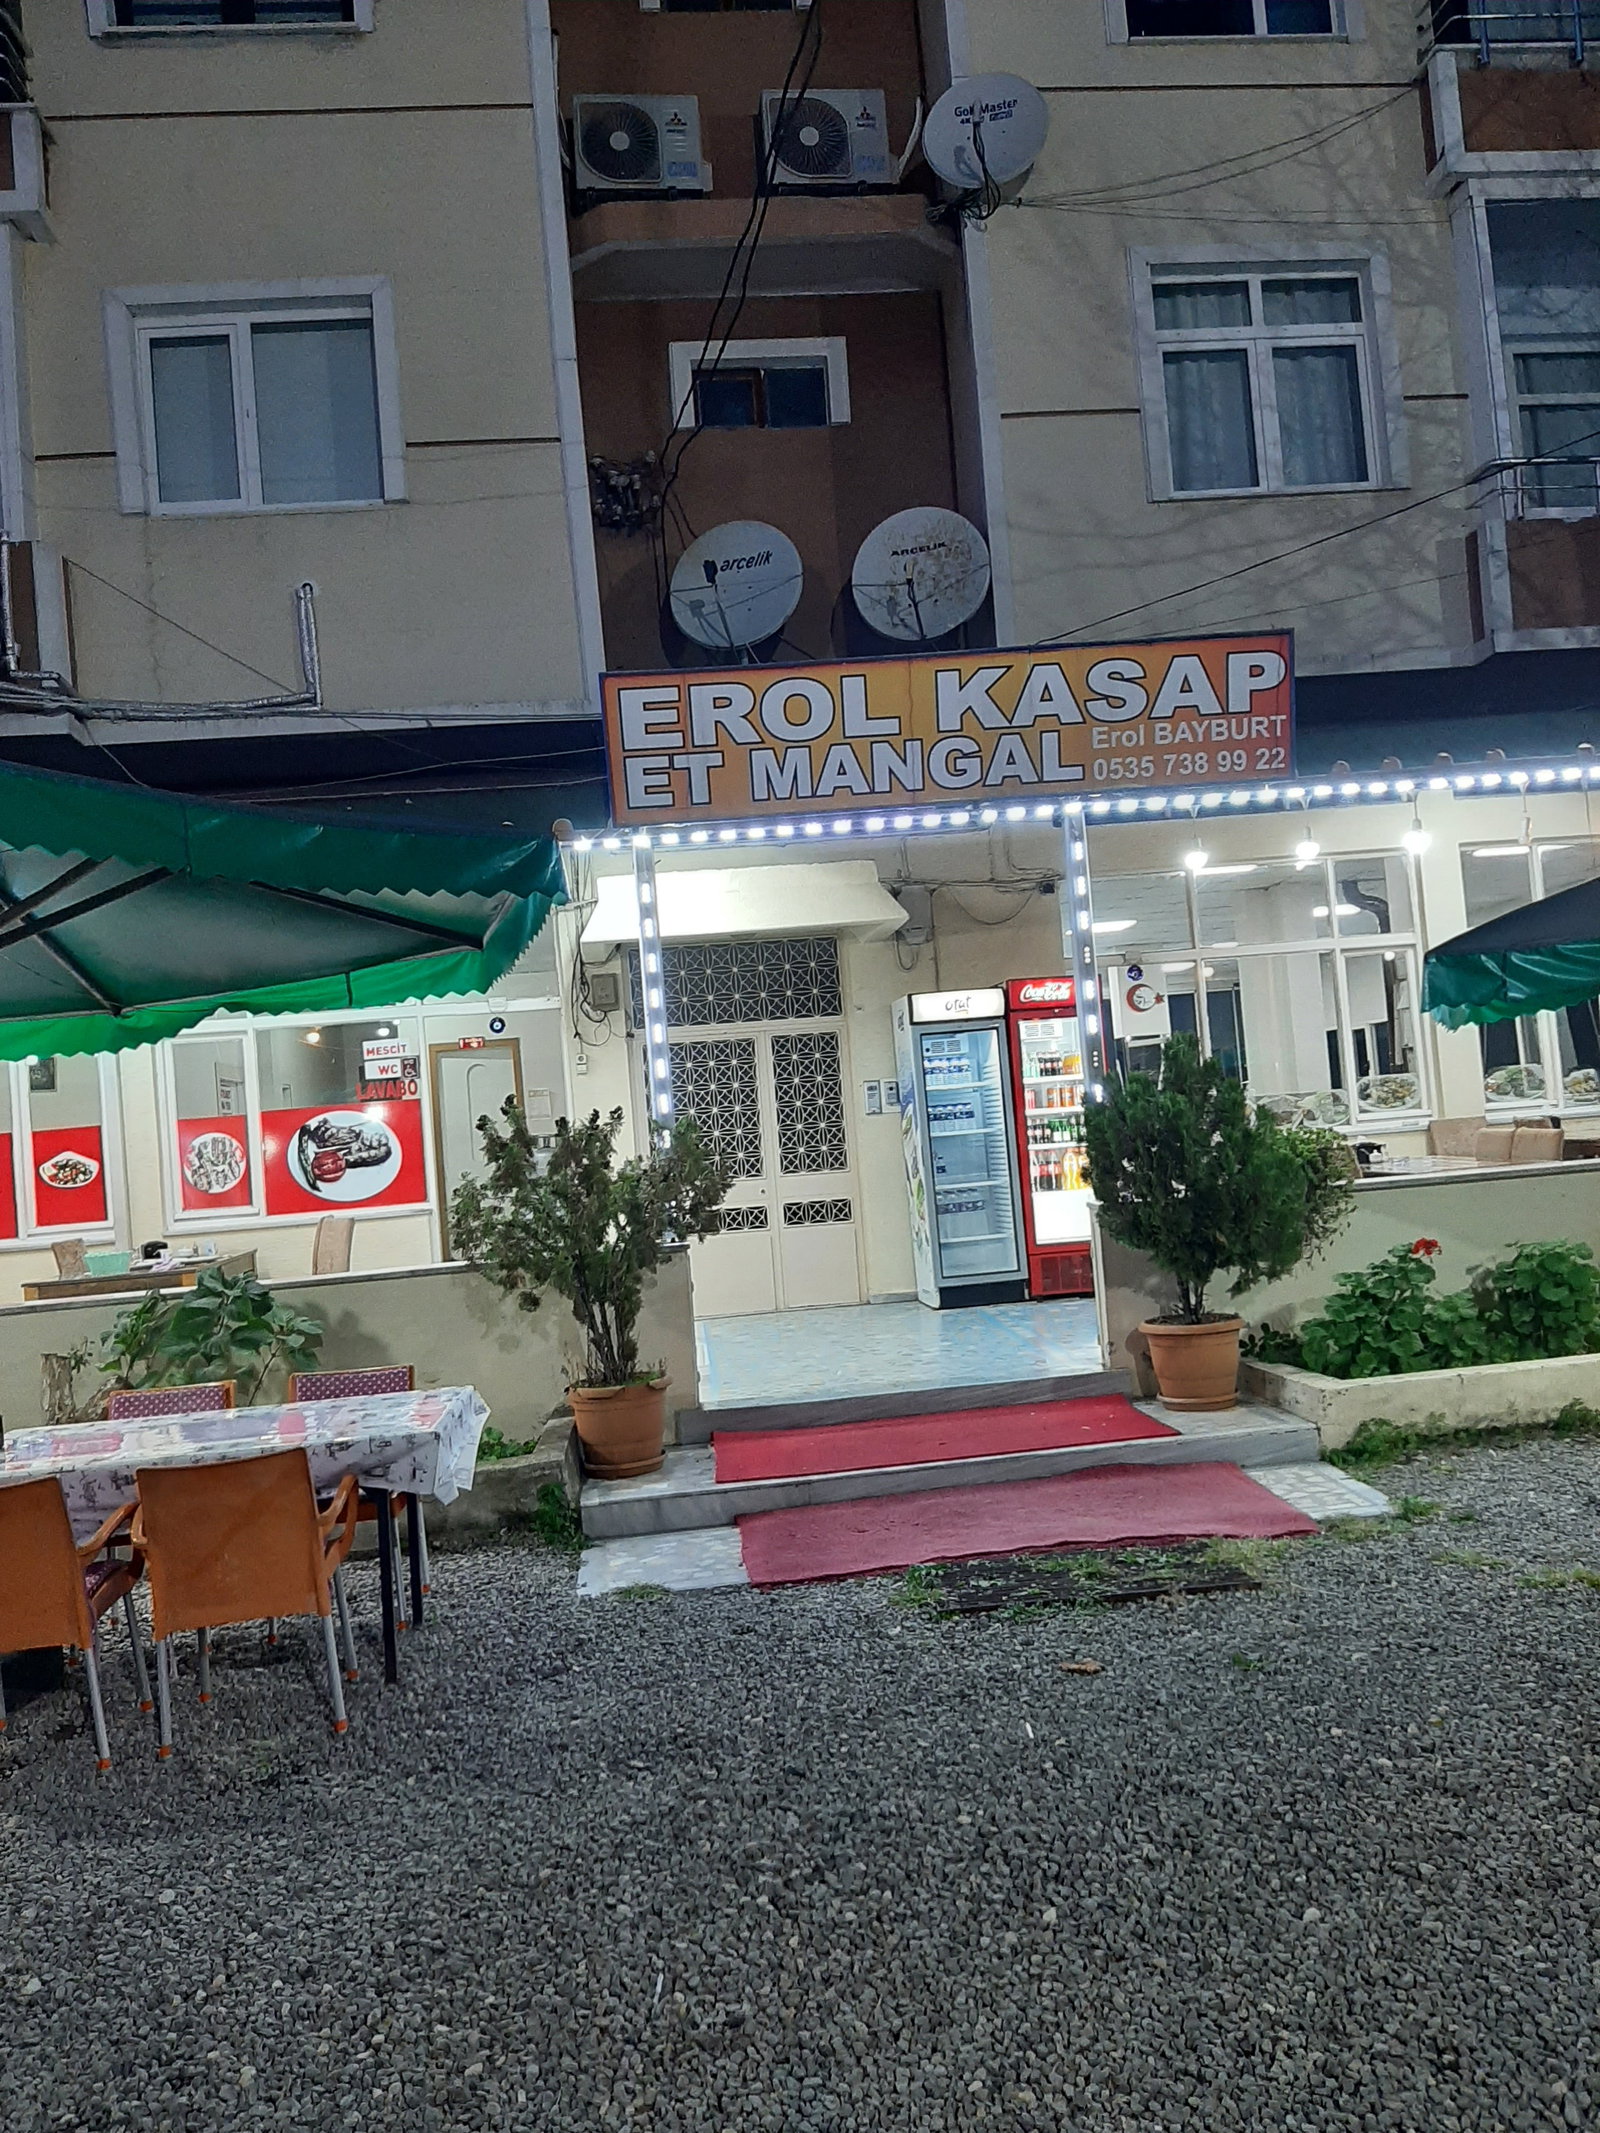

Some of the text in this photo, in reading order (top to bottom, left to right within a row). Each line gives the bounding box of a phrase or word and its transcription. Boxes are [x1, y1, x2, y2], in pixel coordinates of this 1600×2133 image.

[720, 550, 773, 573] arçelik
[618, 650, 1288, 752] EROL KASAP
[1091, 715, 1287, 750] Erol BAYBURT
[623, 730, 1086, 810] ET MANGAL
[1092, 747, 1286, 781] 0535 738 99 22
[377, 1064, 399, 1076] WC
[355, 1079, 418, 1101] LAVABO
